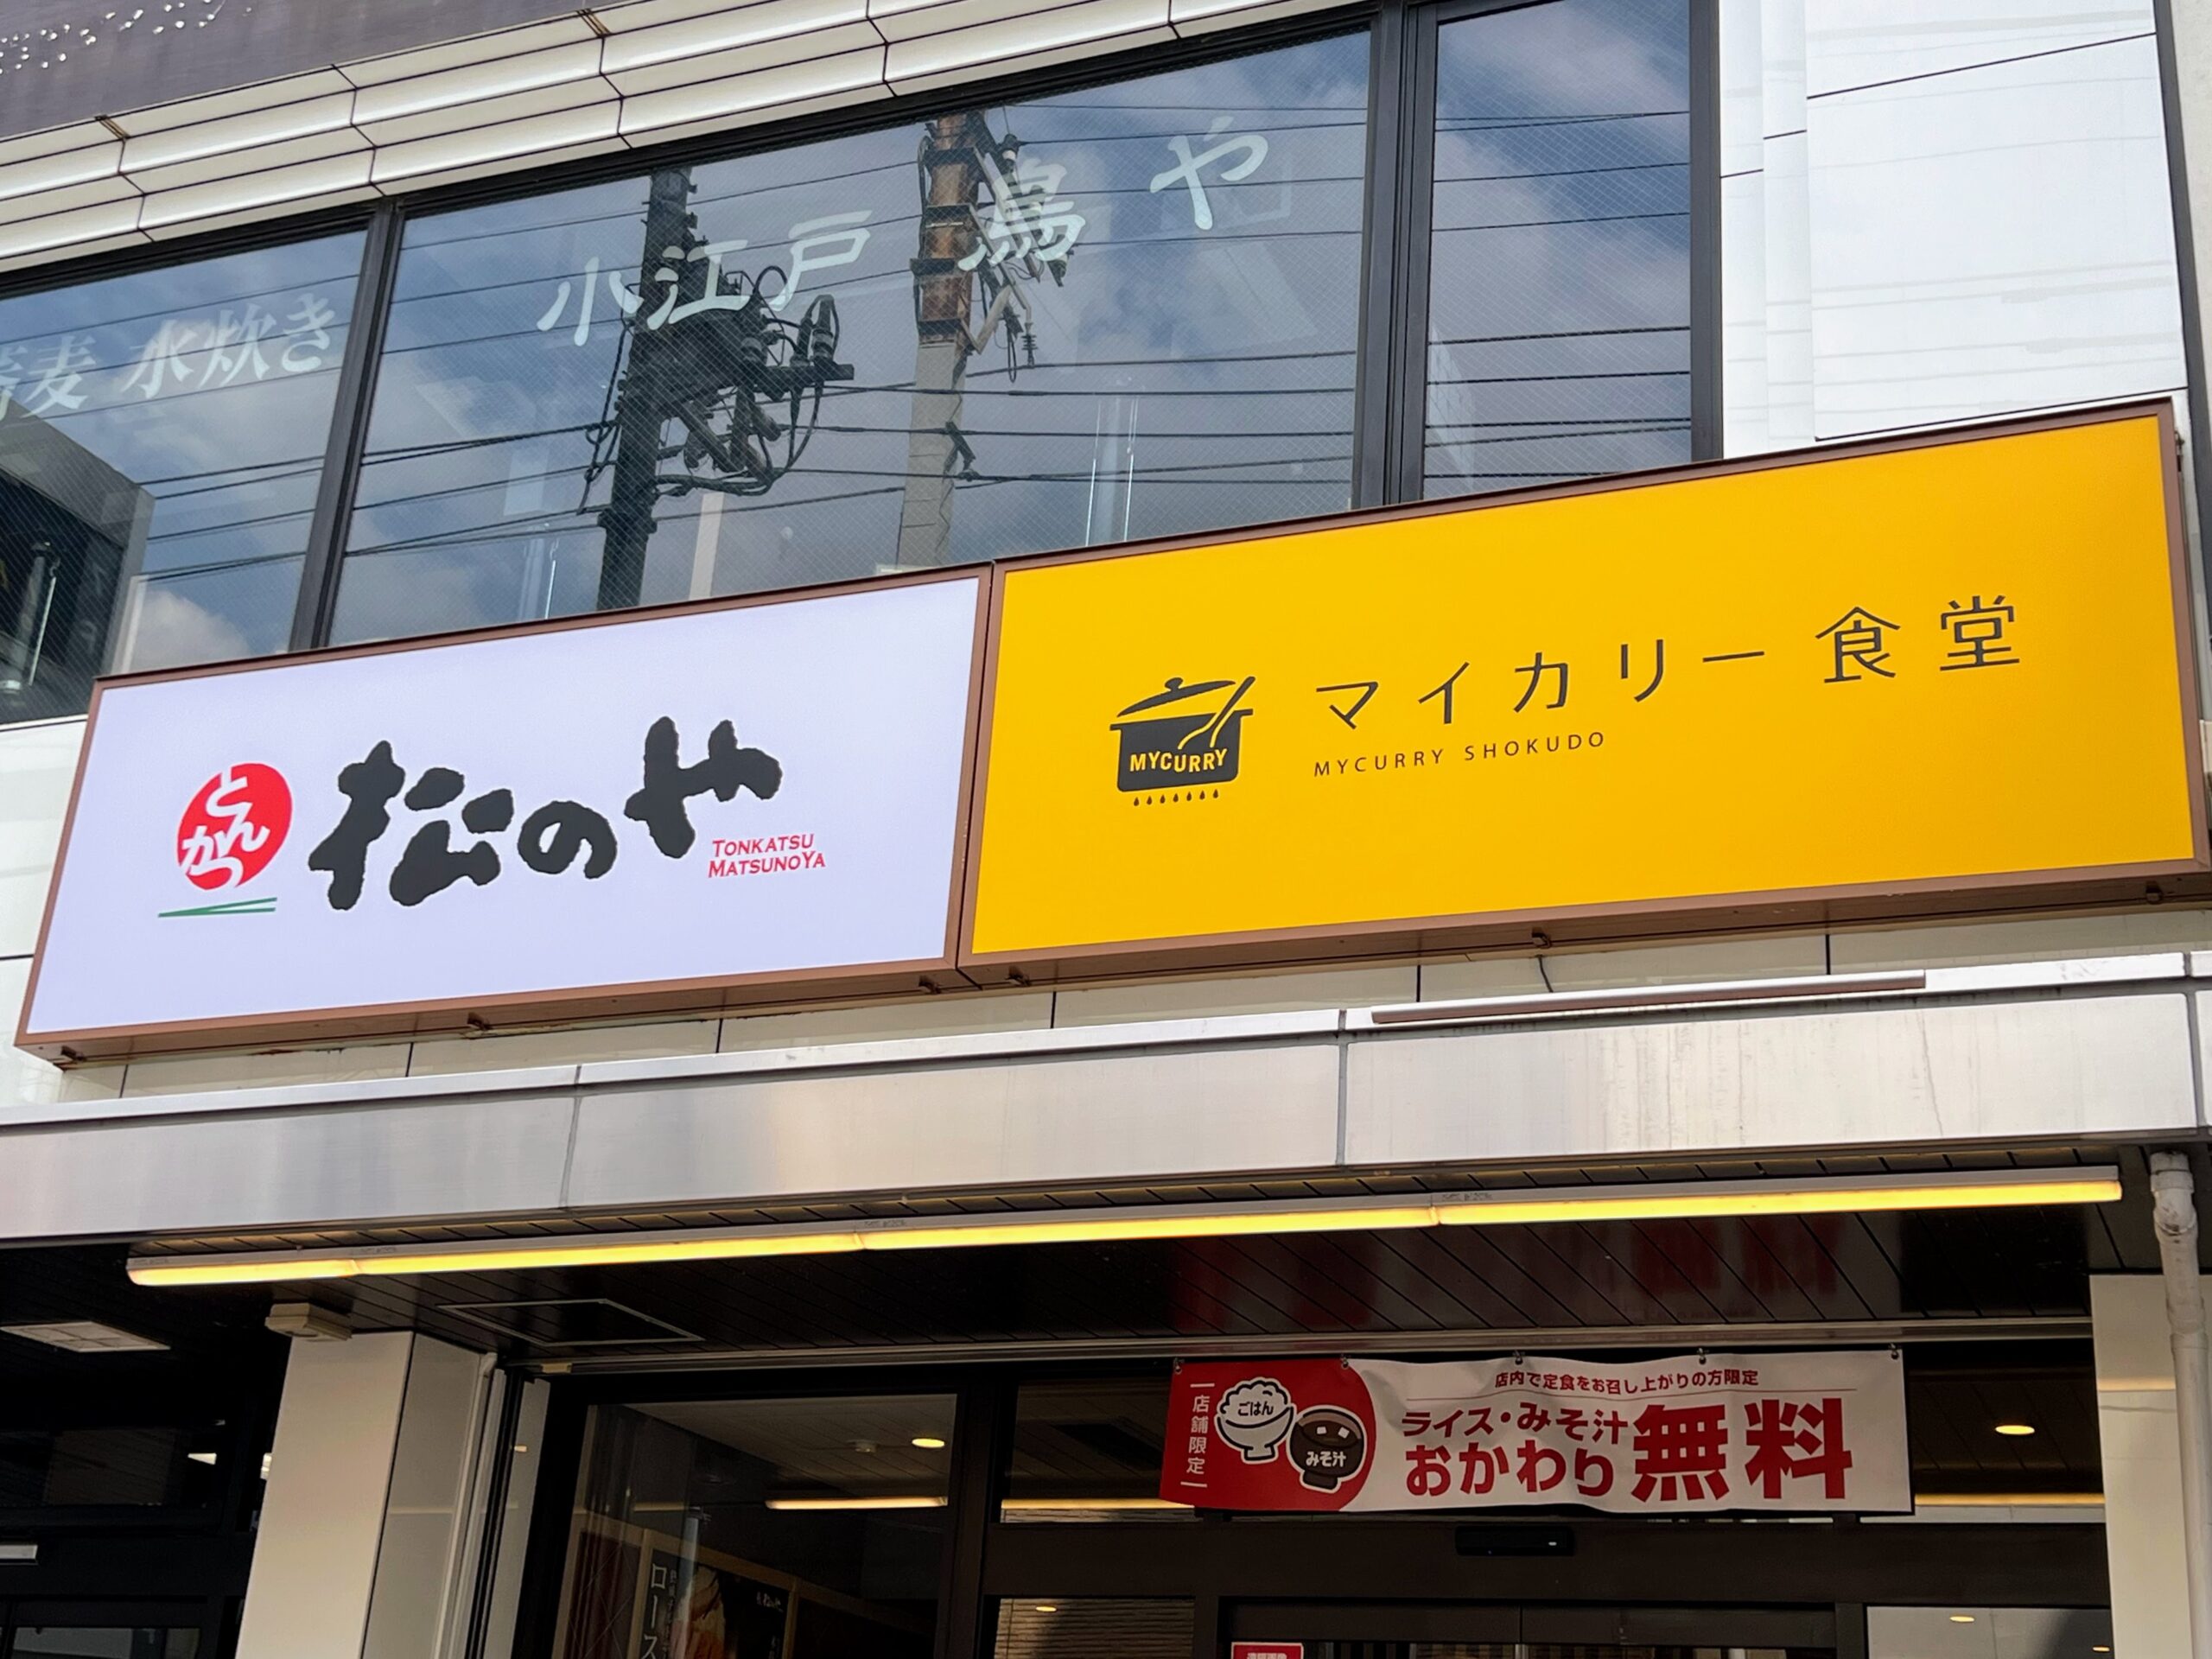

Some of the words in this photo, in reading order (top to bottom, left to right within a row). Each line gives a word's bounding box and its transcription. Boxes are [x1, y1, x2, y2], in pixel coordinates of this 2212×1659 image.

[535, 208, 874, 348] 小江戸
[121, 292, 336, 399] 水炊き
[1315, 594, 2022, 730] マイカリー食堂
[1128, 746, 1229, 774] MYCURRY
[1313, 747, 1446, 778] MYCURRY
[1464, 730, 1605, 762] SHOKUDO
[308, 716, 782, 911] 松のや
[1237, 1401, 1274, 1417] ごはん
[1494, 1368, 1758, 1395] 店内で定食をお召し上がりの方限定
[1185, 1394, 1211, 1476] 店舗限定
[1401, 1401, 1630, 1445] ライス・みそ汁
[1630, 1396, 1853, 1502] 無料
[1305, 1450, 1348, 1468] みそ汁
[1404, 1439, 1616, 1498] おかわり
